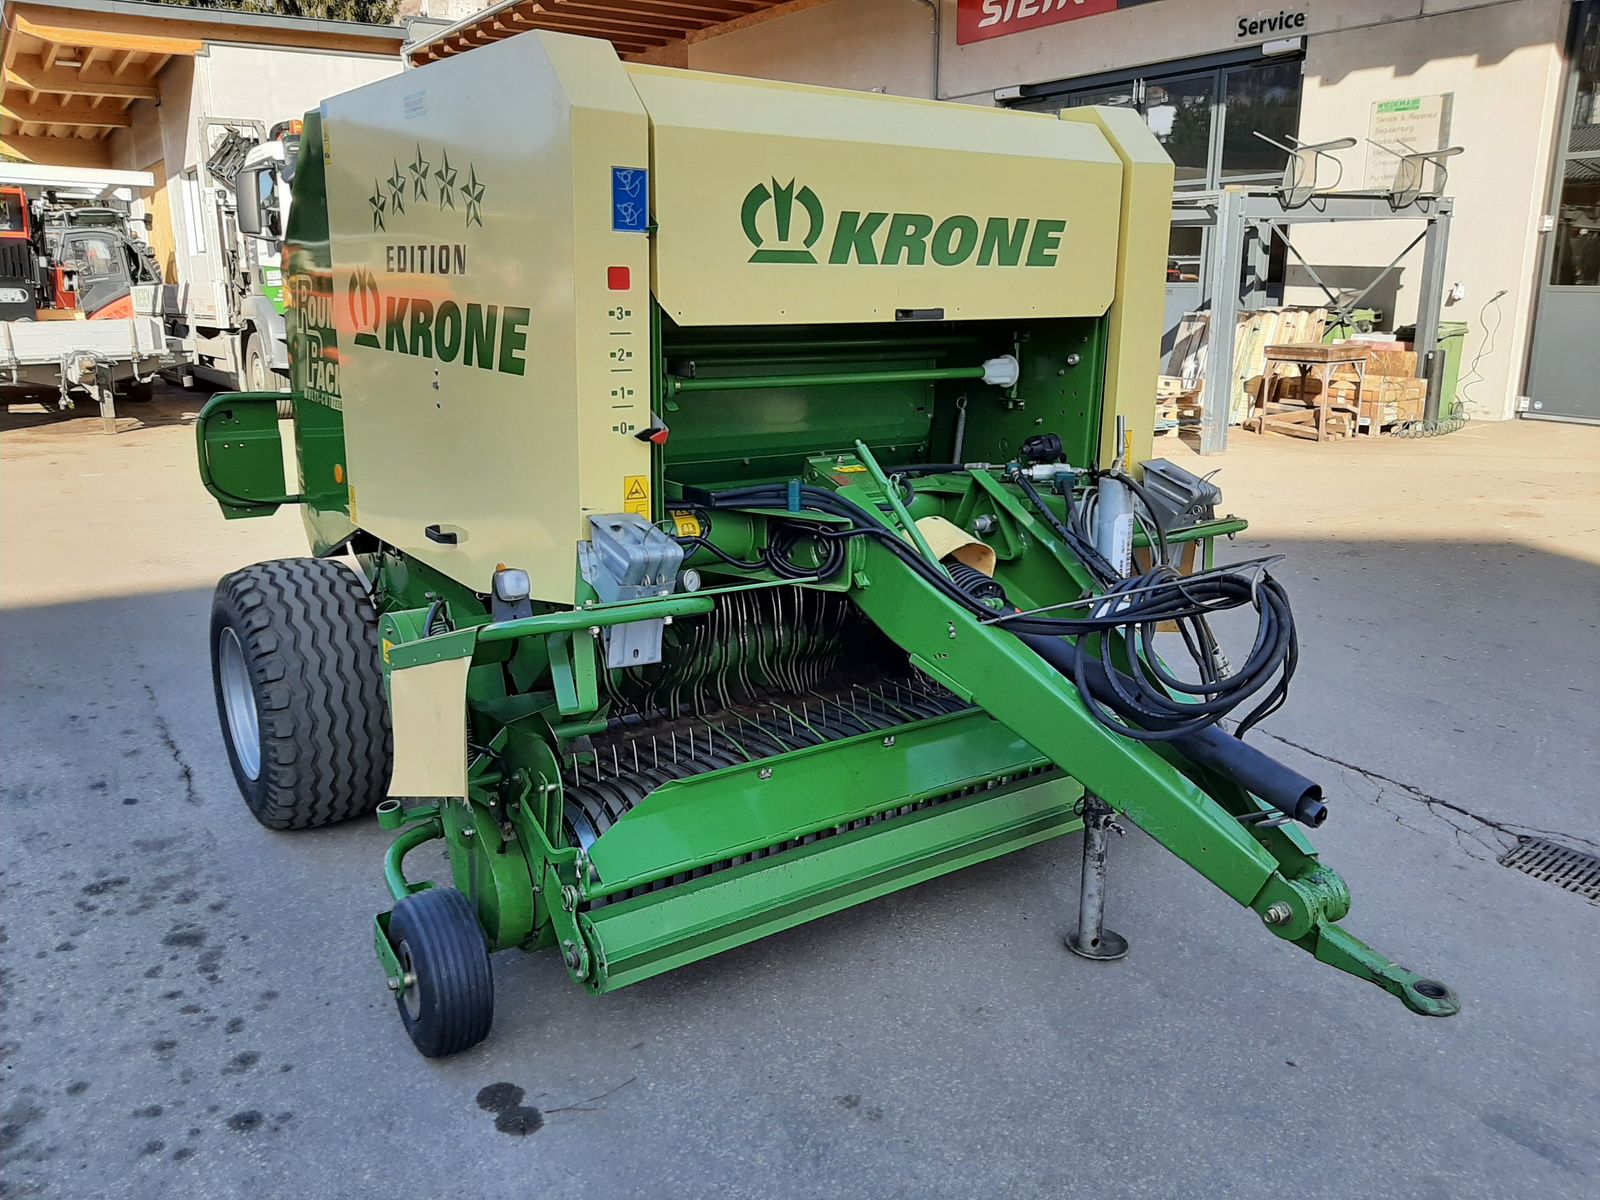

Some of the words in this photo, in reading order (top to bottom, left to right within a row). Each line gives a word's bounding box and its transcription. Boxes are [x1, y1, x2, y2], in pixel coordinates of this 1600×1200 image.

[1237, 11, 1306, 38] Service
[828, 211, 1067, 267] KRONE
[386, 244, 467, 275] EDITION
[616, 306, 624, 321] 3
[385, 296, 531, 377] KRONE
[618, 348, 625, 361] 2
[620, 422, 627, 435] 0
